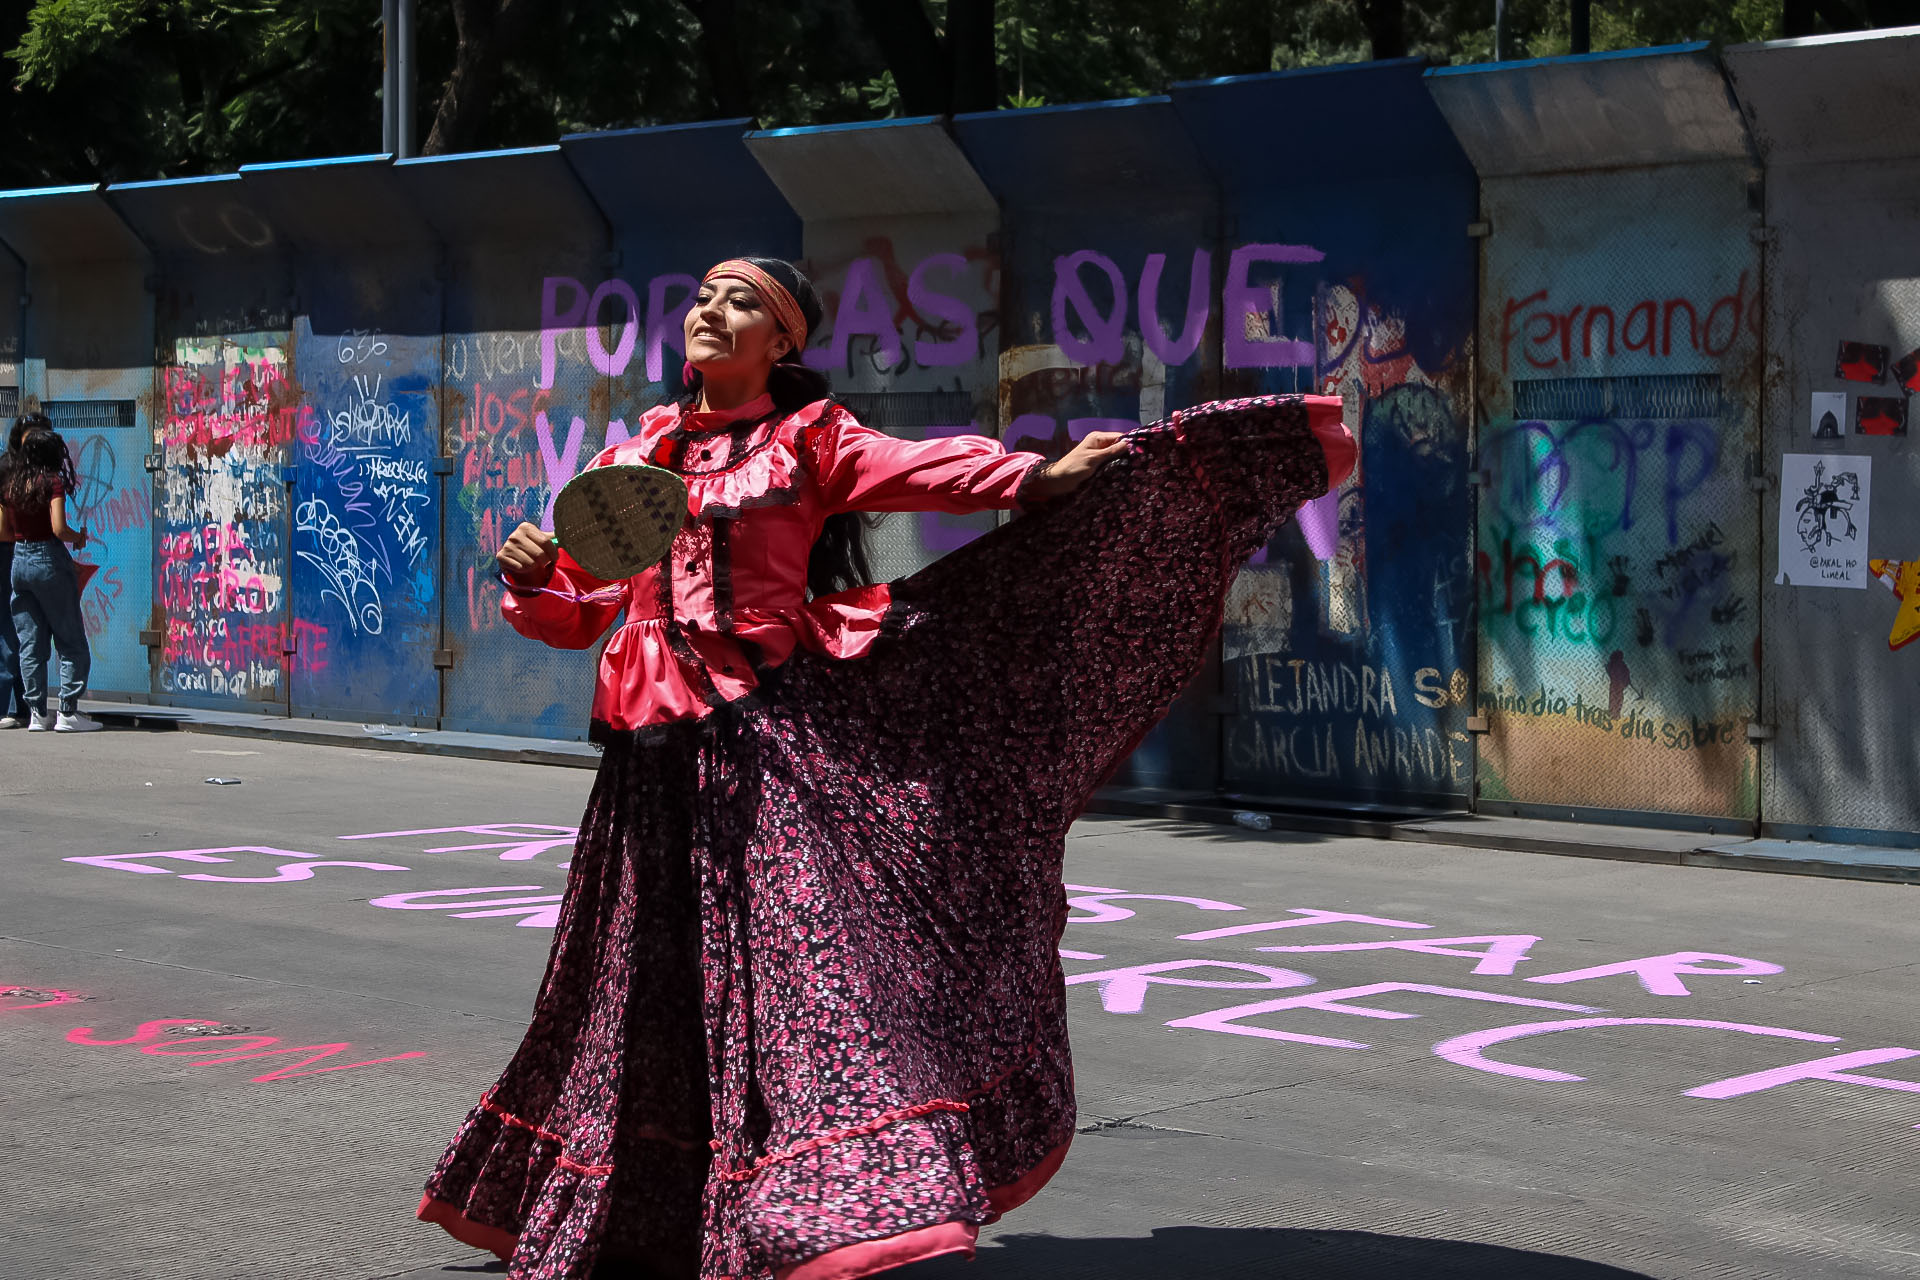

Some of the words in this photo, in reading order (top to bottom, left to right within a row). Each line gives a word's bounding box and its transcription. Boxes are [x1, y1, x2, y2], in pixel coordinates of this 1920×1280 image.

[540, 272, 698, 390] POR
[1050, 242, 1327, 369] QUE
[535, 411, 586, 534] Y
